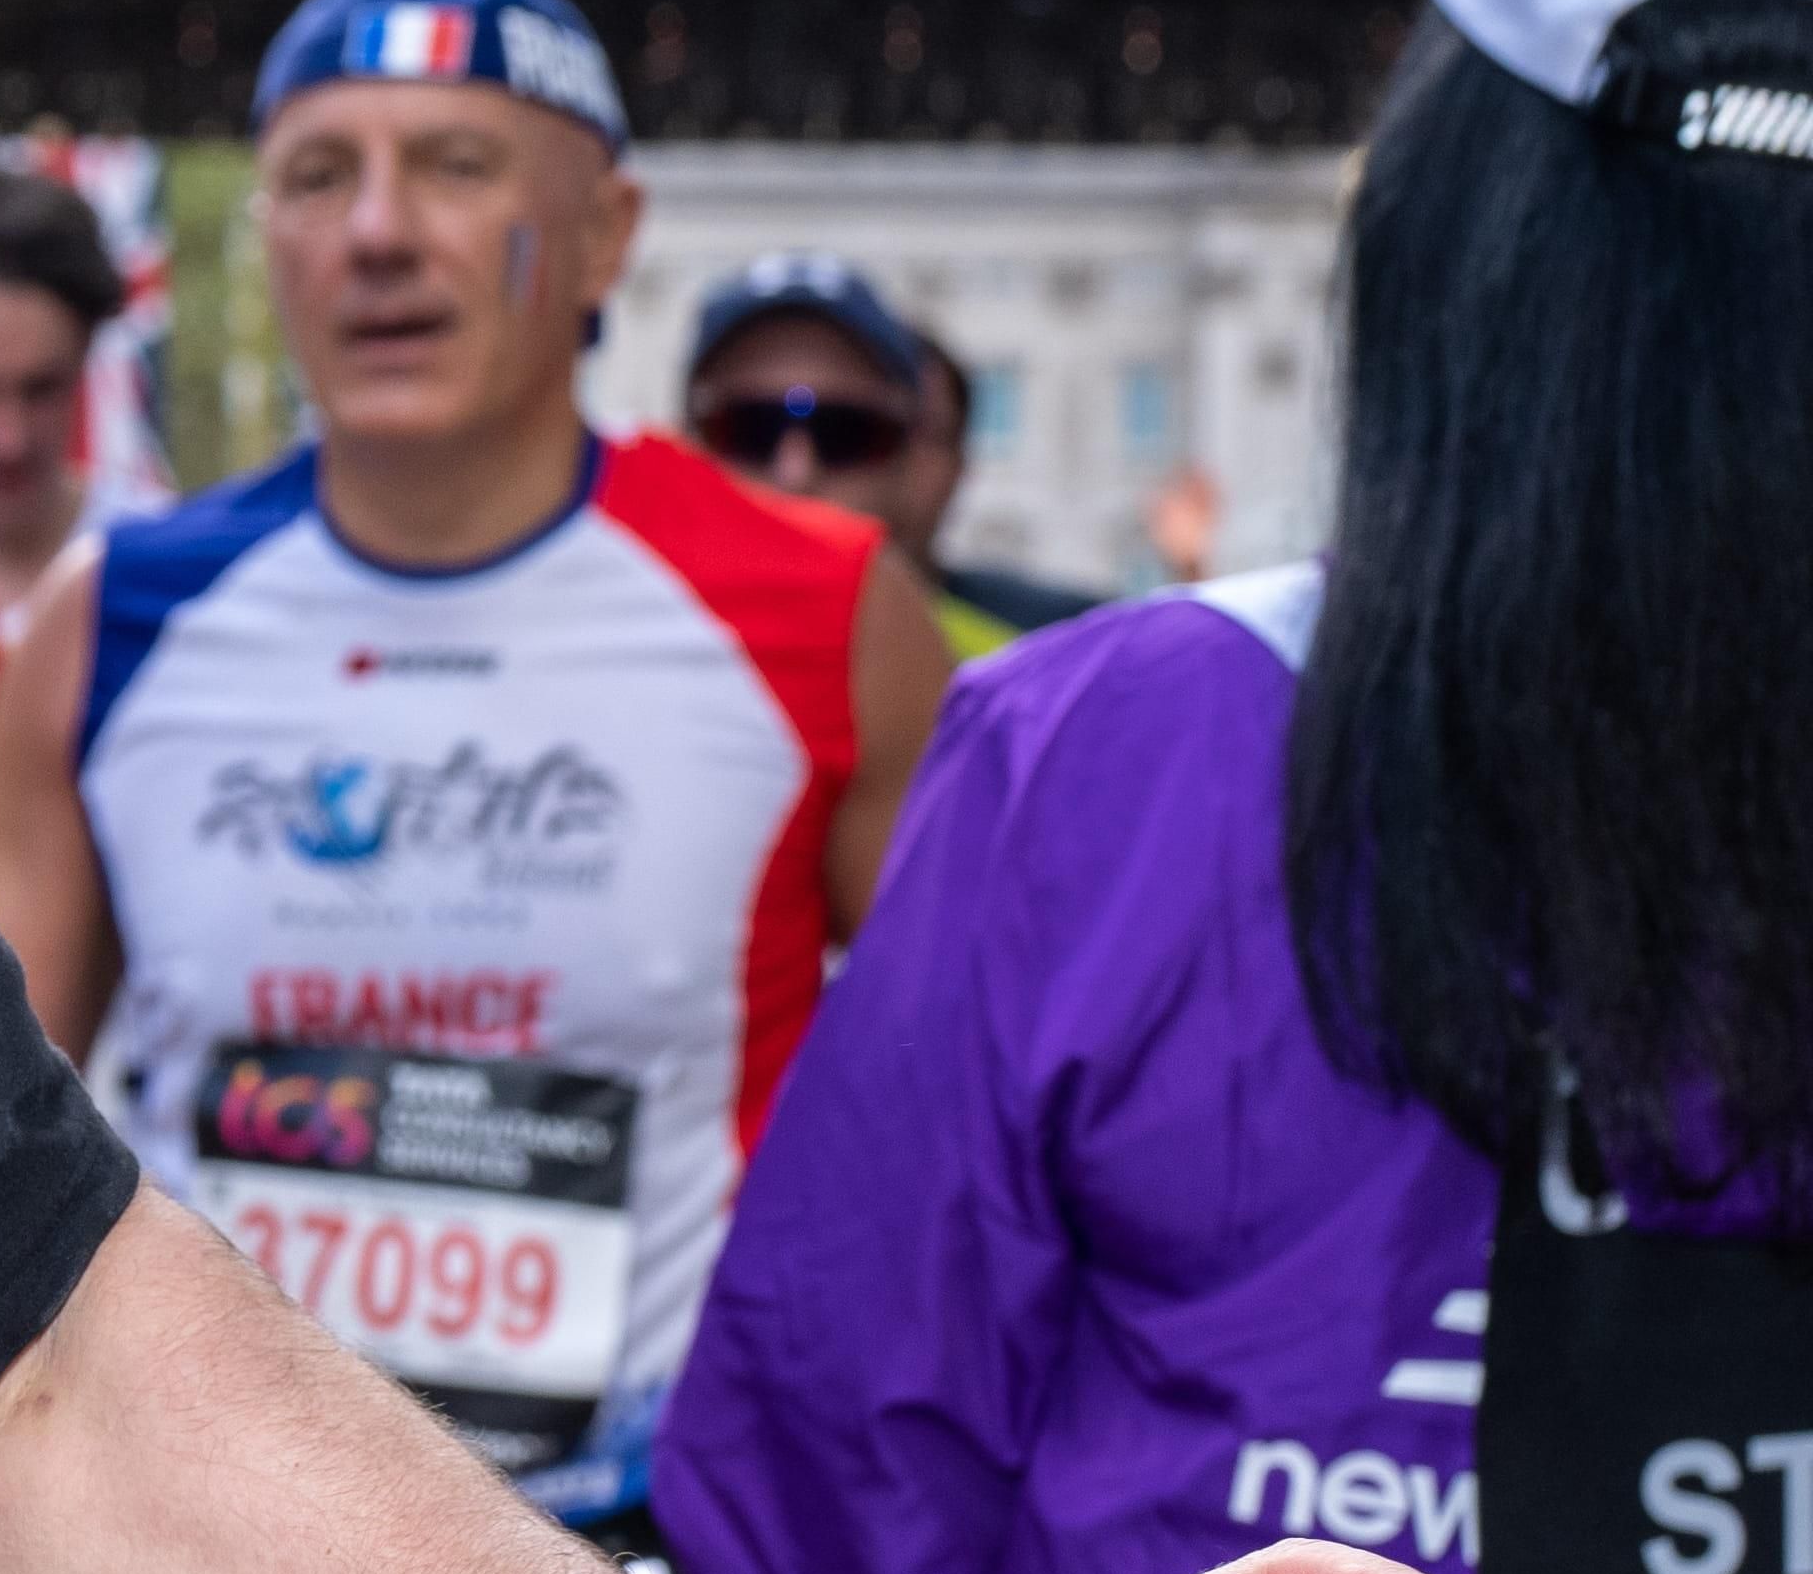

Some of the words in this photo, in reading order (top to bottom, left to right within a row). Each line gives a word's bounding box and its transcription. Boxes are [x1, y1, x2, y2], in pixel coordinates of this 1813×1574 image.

[249, 967, 560, 1053] FRANCE
[215, 1057, 377, 1167] tcs
[1228, 1439, 1481, 1567] new
